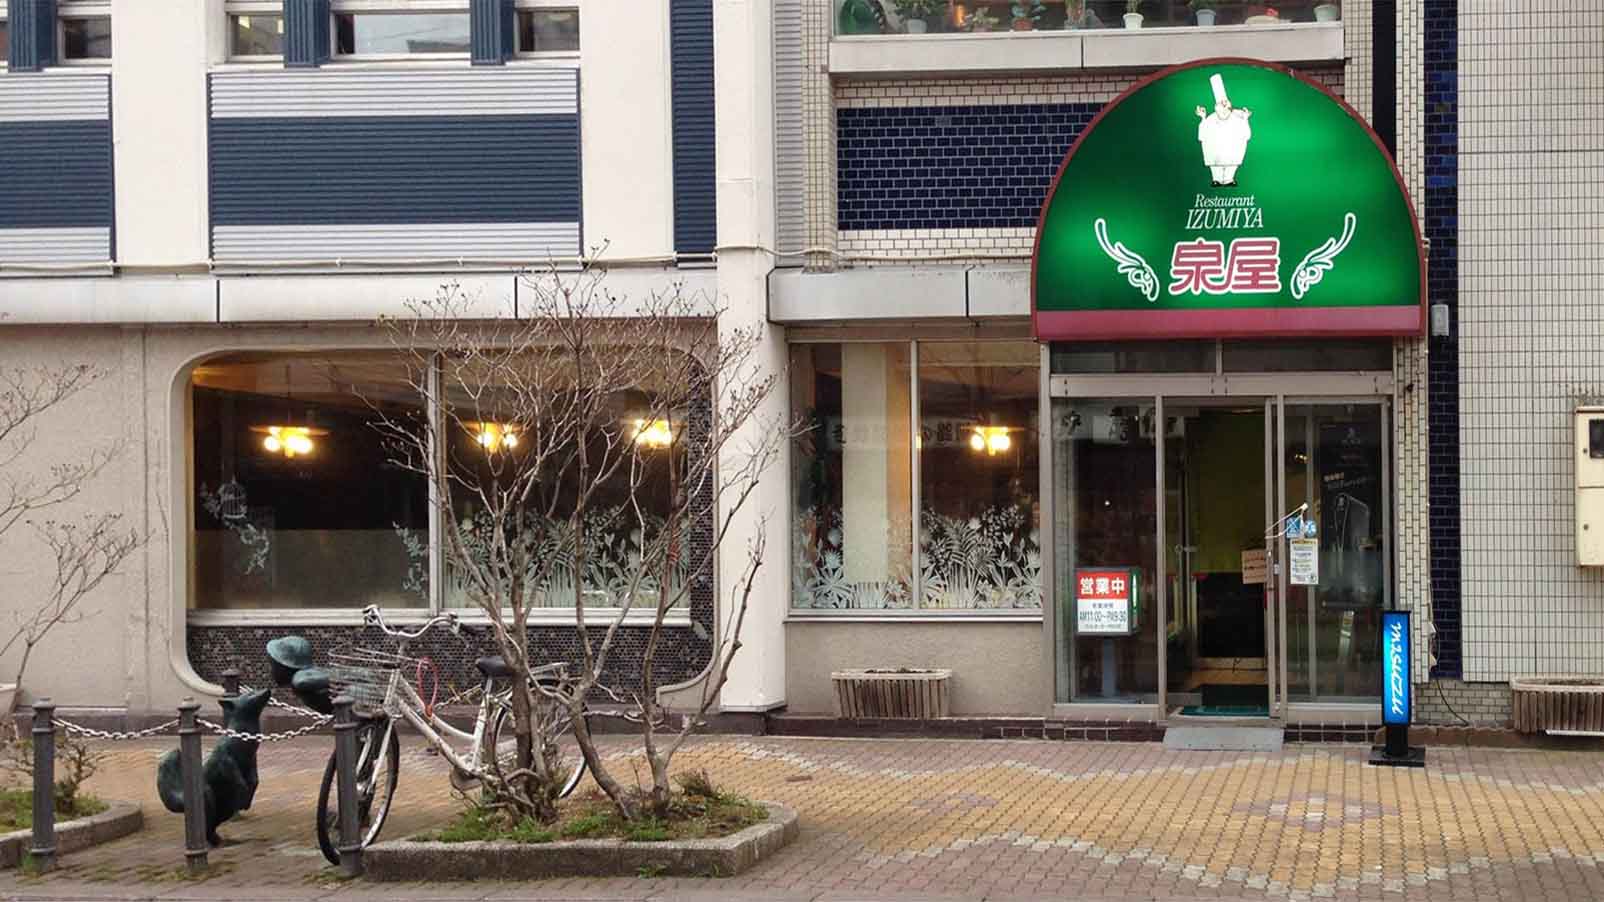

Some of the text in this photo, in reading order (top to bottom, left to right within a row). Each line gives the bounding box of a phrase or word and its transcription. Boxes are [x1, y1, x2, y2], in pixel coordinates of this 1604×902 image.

[1194, 193, 1255, 208] Restaurant
[1185, 207, 1264, 230] IZUMIYA
[1168, 237, 1282, 295] 泉屋
[1080, 576, 1125, 595] 営業中
